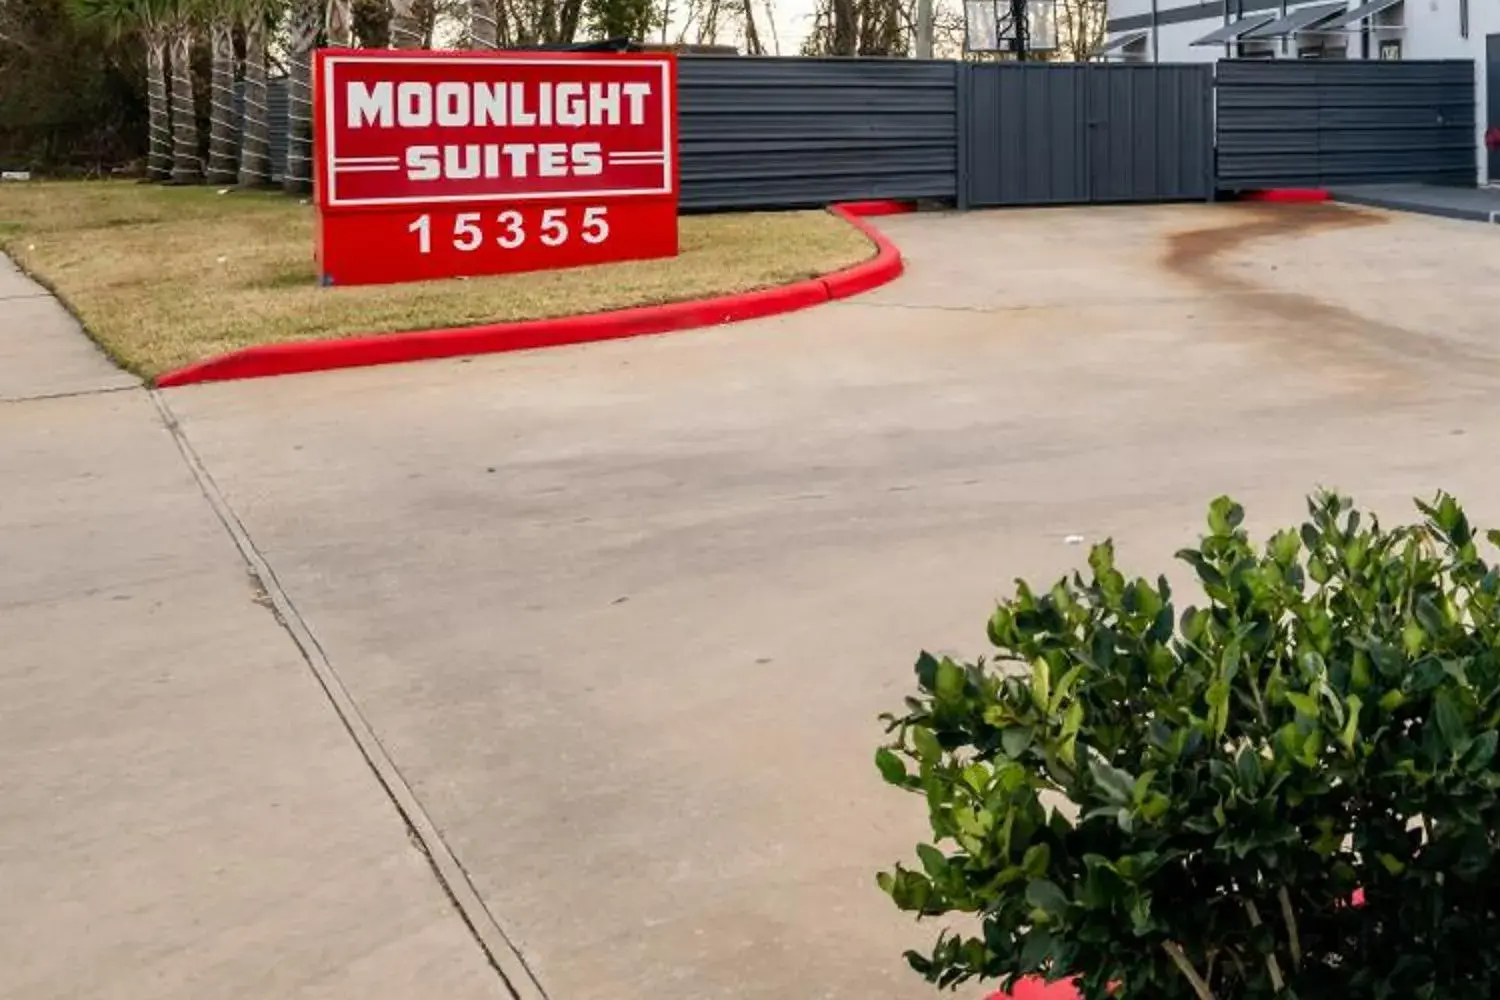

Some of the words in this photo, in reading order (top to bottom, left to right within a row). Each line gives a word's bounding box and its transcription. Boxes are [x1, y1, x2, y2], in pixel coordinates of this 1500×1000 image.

[347, 82, 651, 128] MOONLIGHT
[405, 142, 603, 181] SUITES
[409, 206, 610, 254] 15355
